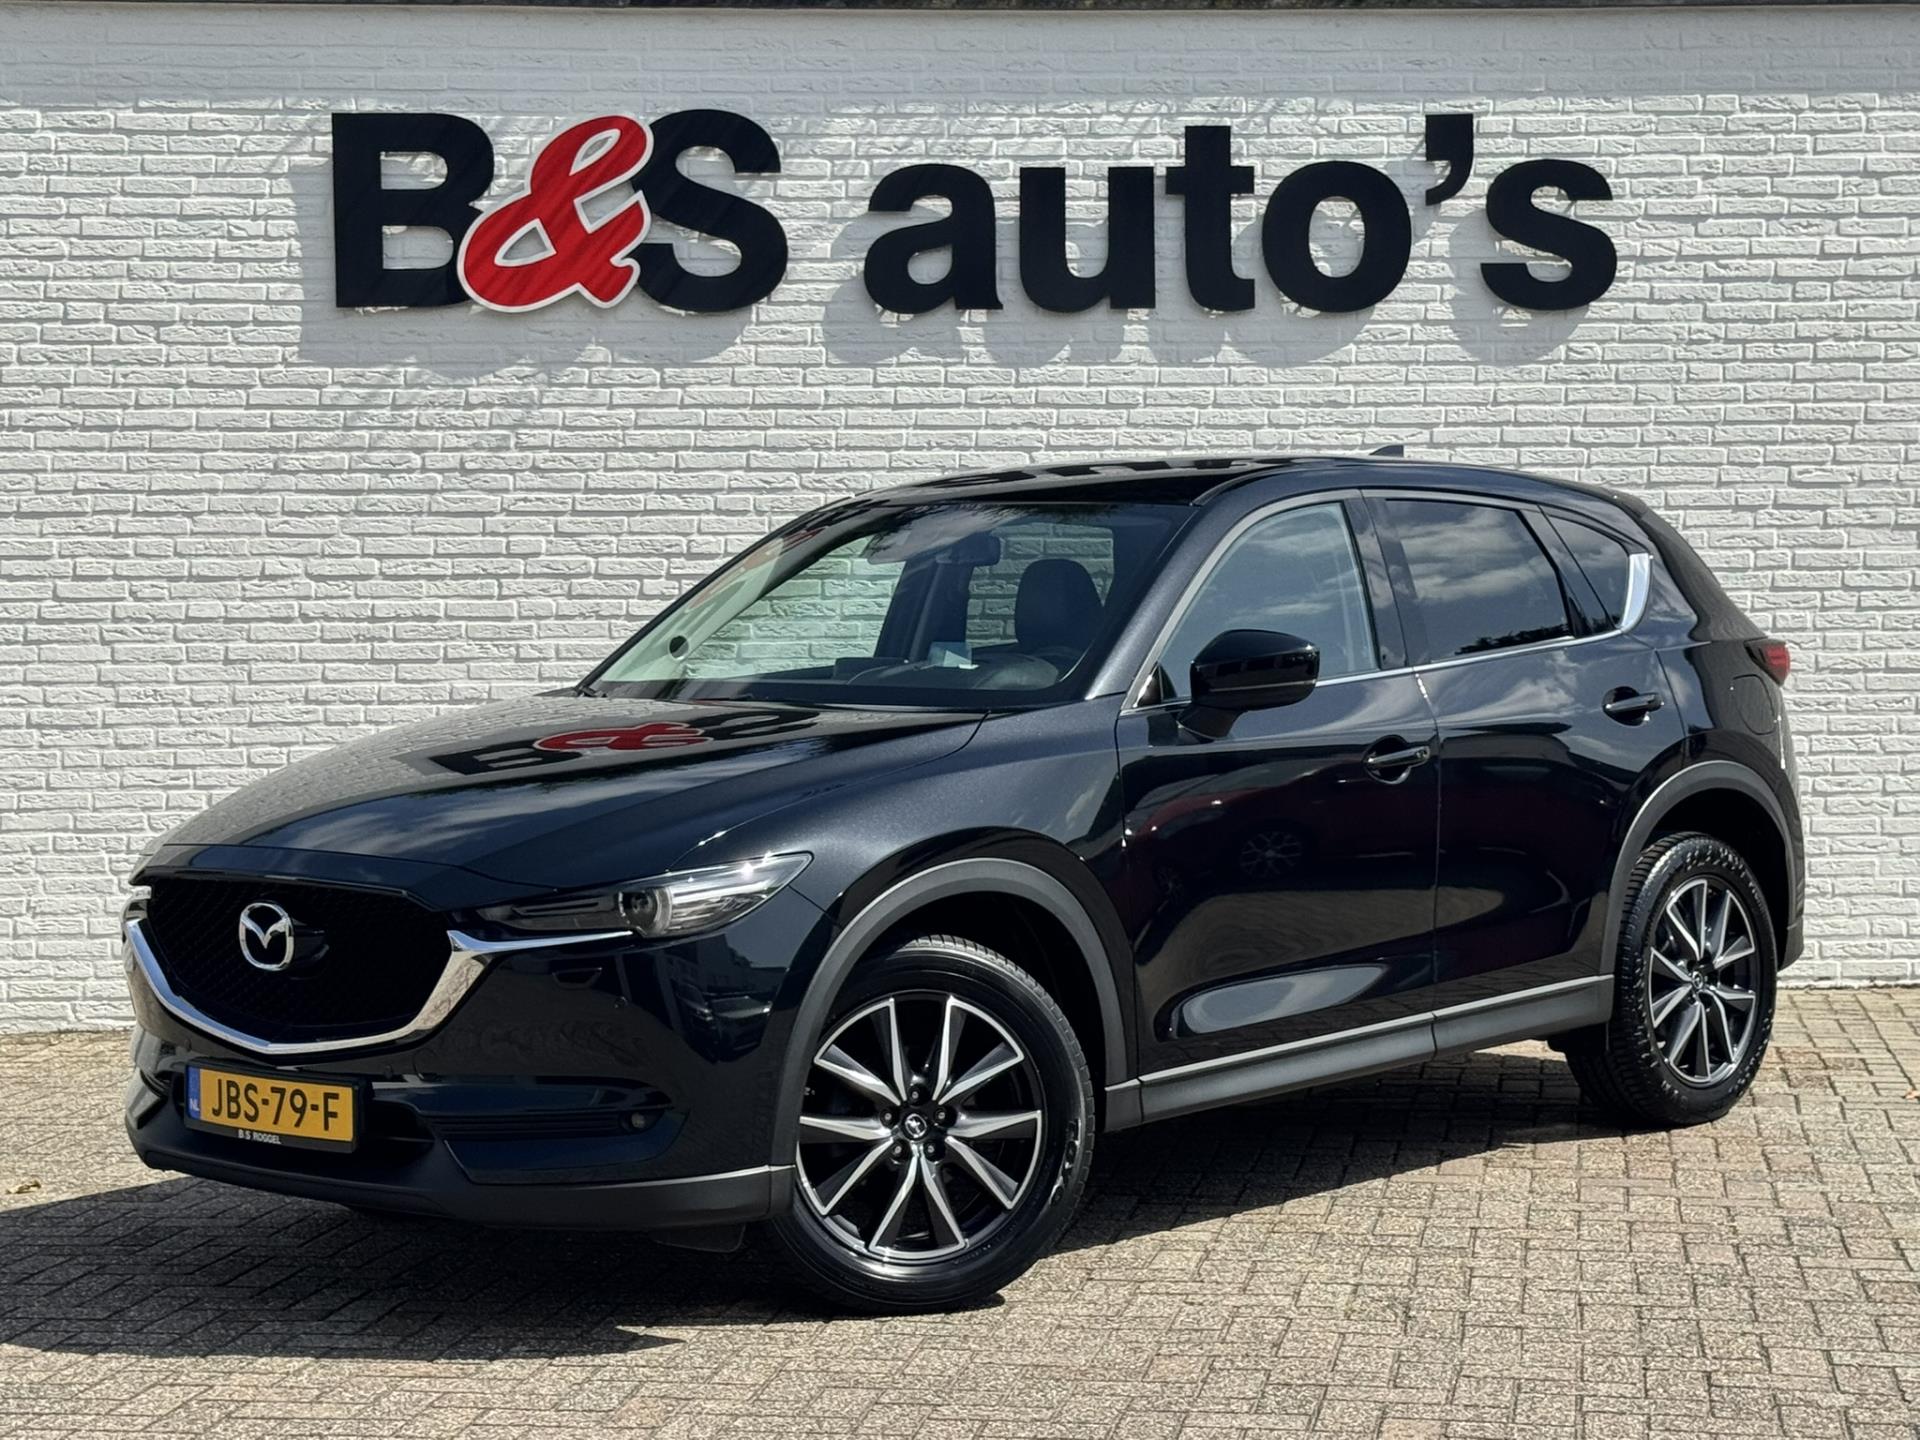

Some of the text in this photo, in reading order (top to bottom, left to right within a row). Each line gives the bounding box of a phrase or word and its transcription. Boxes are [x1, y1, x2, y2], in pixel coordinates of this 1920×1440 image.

[331, 109, 1618, 314] B&S auto's
[189, 1097, 200, 1112] NL
[211, 1078, 340, 1132] JBS-79-F
